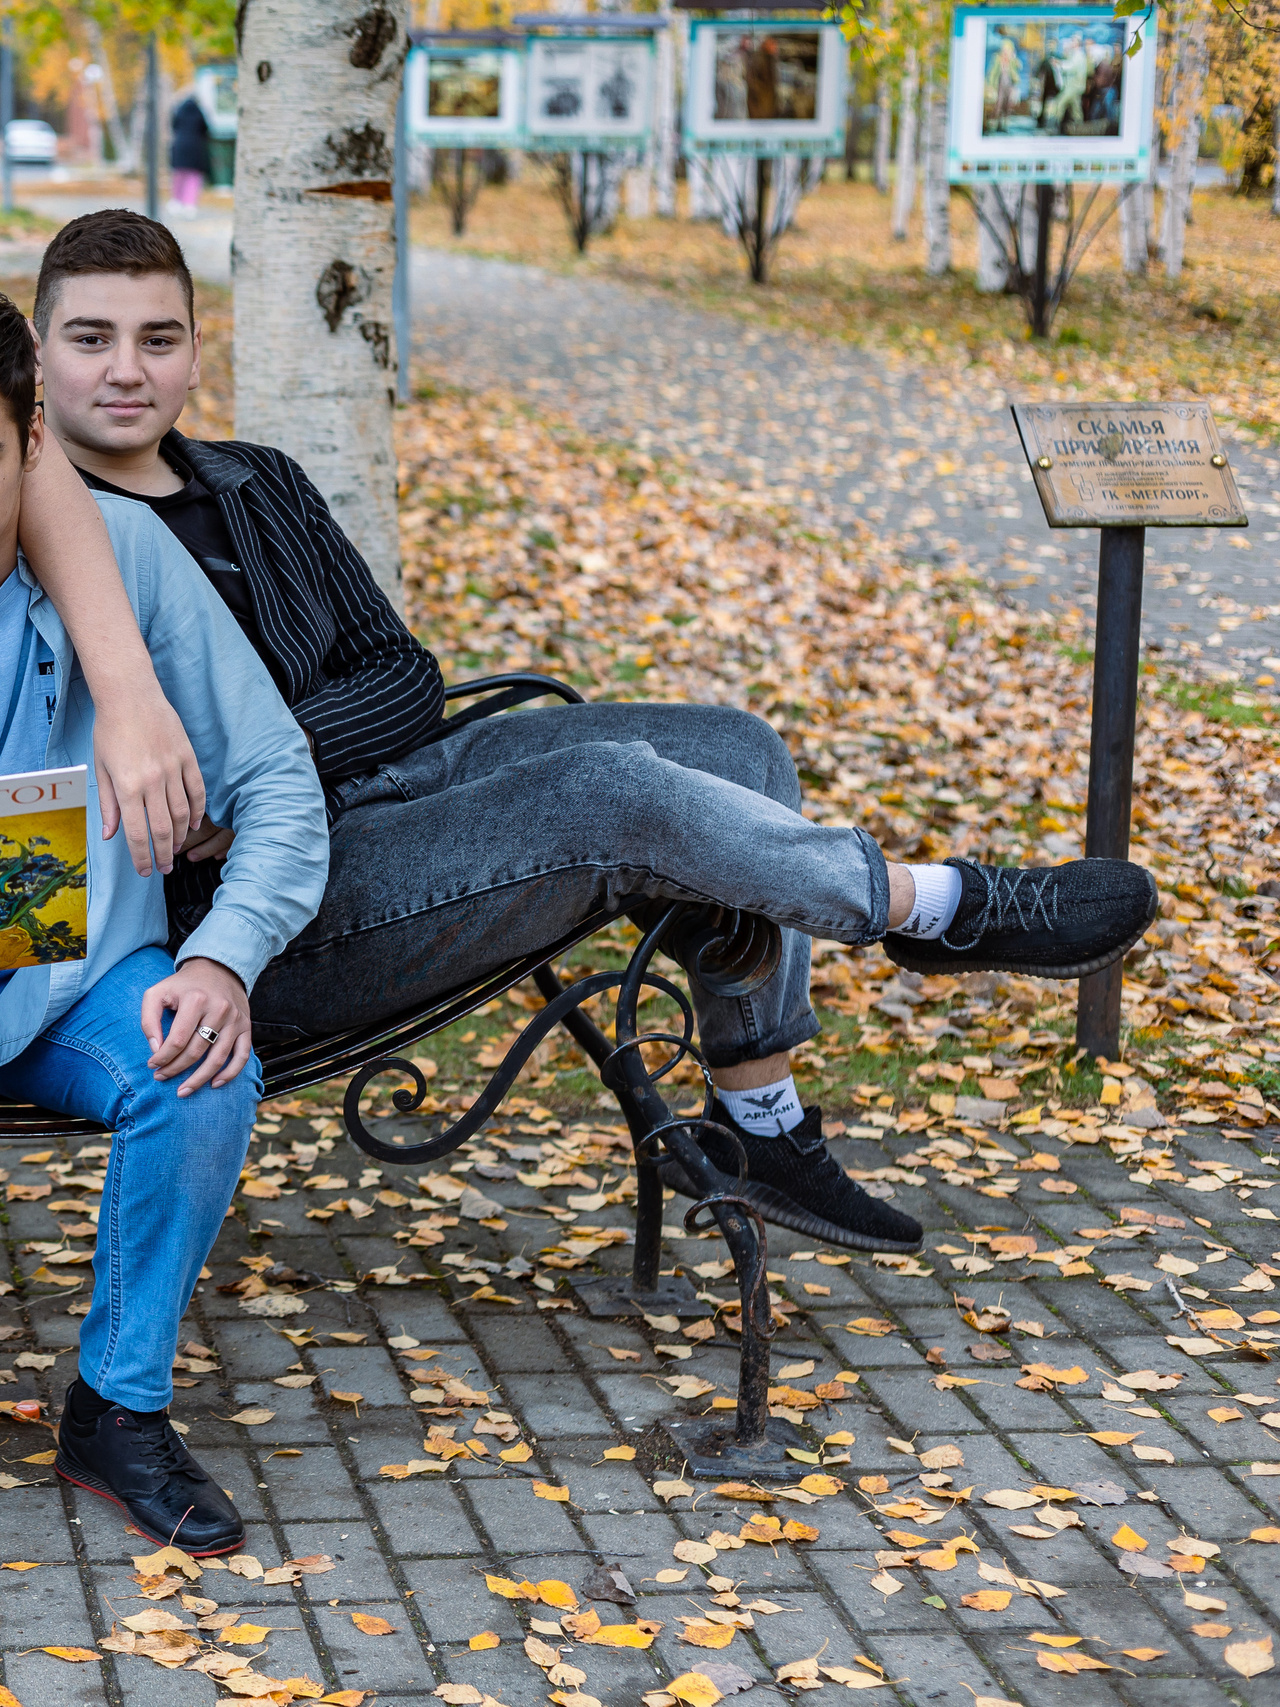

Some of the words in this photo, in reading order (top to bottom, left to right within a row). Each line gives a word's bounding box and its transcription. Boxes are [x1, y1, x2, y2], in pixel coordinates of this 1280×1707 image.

[1077, 420, 1166, 435] СКАМЬЯ
[1053, 439, 1201, 455] ПРИИРЕНИЯ
[1101, 489, 1120, 501] ГК
[1124, 489, 1209, 501] «МЕГАТОРГ»
[742, 1101, 796, 1121] ARMANI
